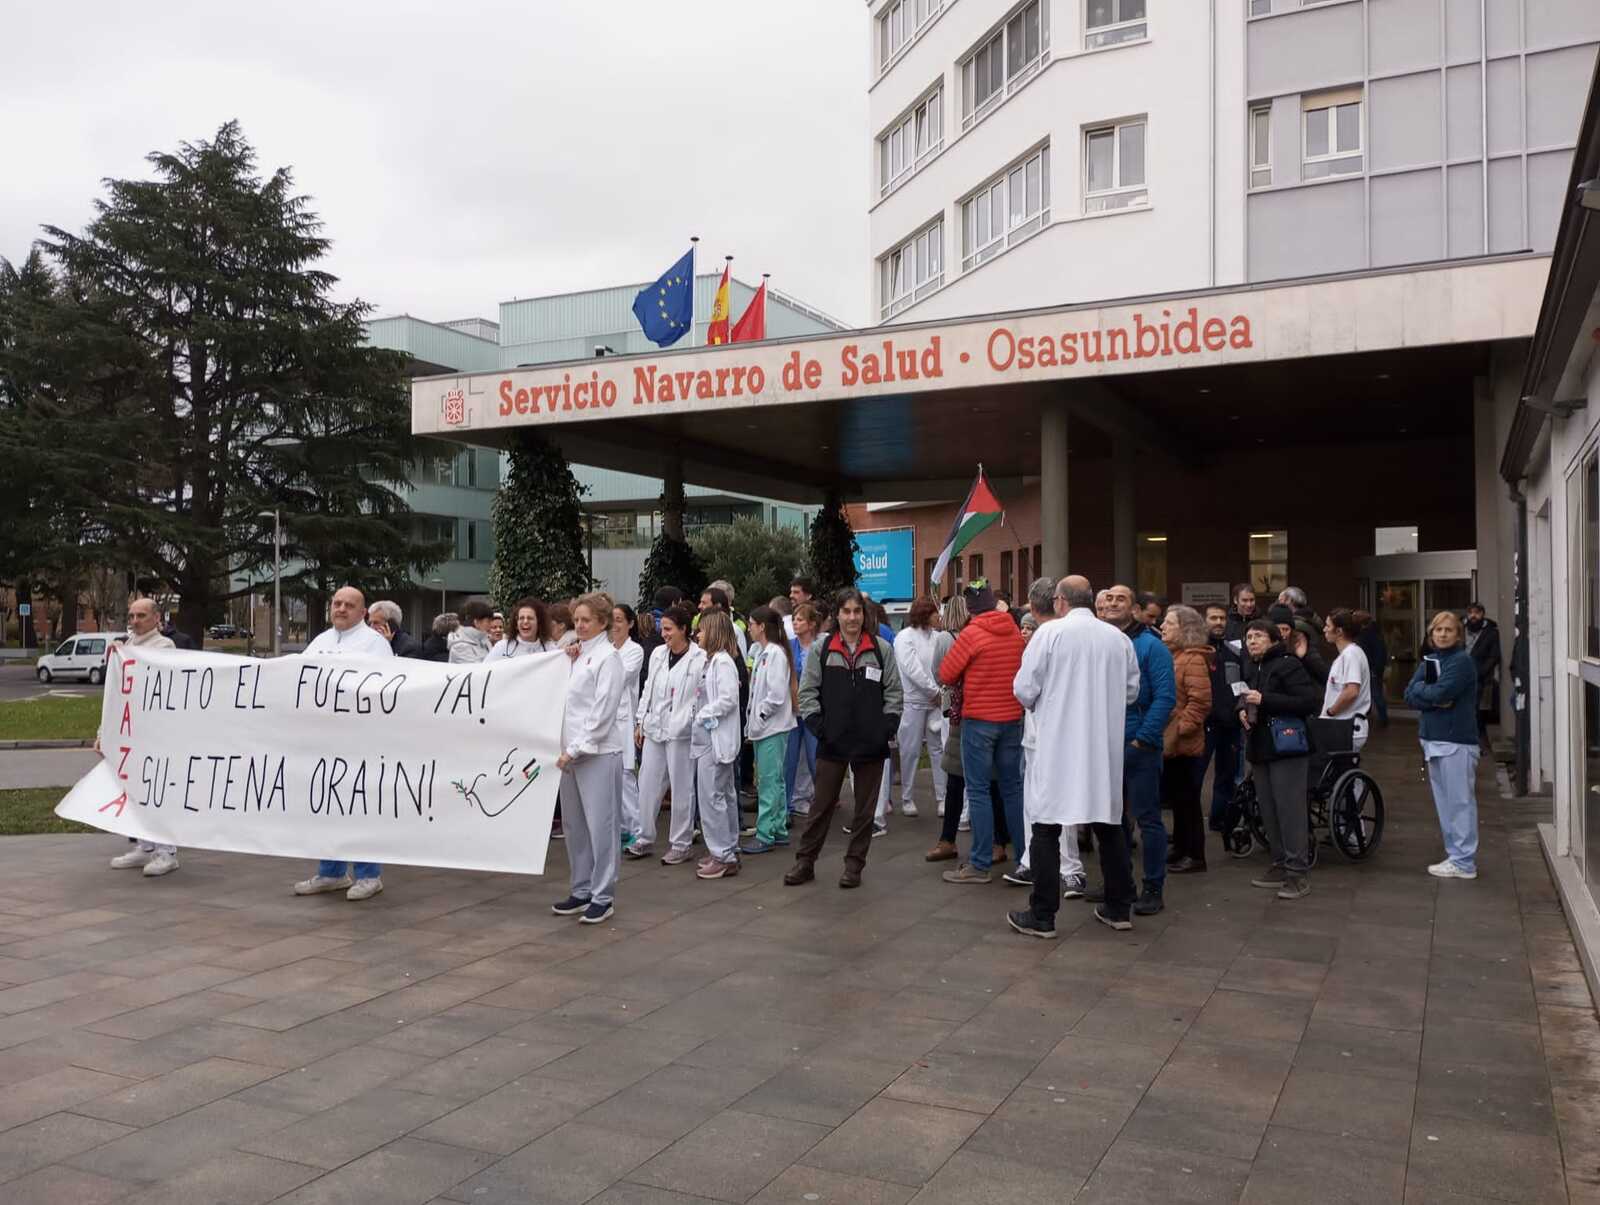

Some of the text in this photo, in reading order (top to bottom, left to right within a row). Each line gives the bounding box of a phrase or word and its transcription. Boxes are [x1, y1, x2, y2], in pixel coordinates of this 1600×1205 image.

[499, 308, 1253, 416] Servicio Navarro de Salud Osasunbidea
[860, 552, 888, 570] Salud
[234, 664, 266, 709] EL
[295, 664, 407, 714] FUEGO
[433, 669, 492, 725] YA!
[139, 754, 286, 812] SU-ETENA
